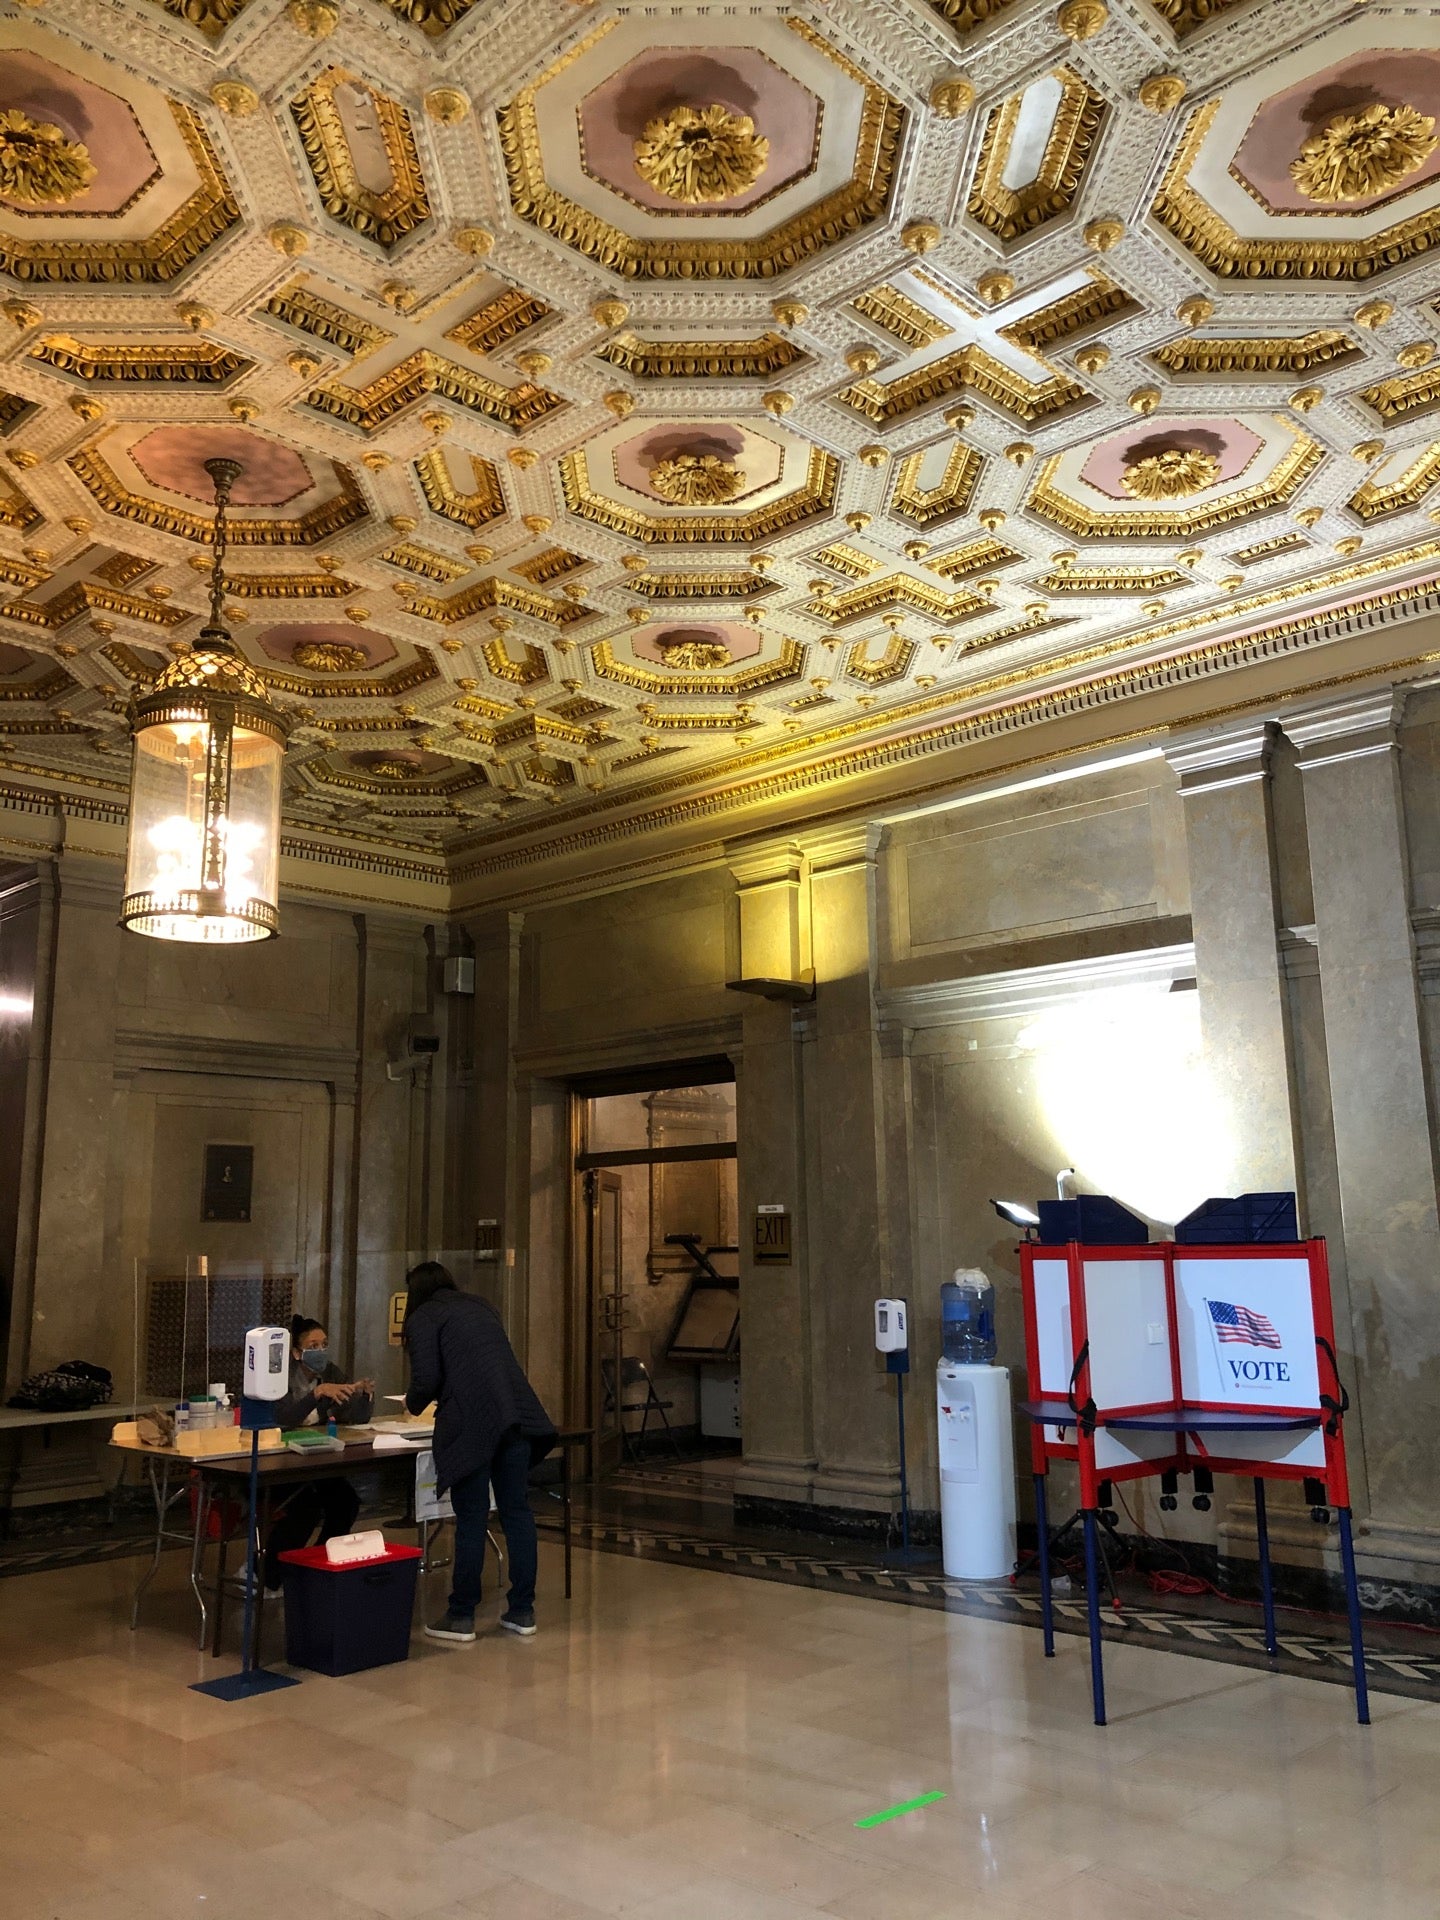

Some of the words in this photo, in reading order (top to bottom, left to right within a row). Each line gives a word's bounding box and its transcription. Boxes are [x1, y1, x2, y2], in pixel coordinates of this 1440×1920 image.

[475, 1227, 500, 1250] EXIT
[755, 1216, 786, 1245] EXIT
[1227, 1359, 1290, 1382] VOTE
